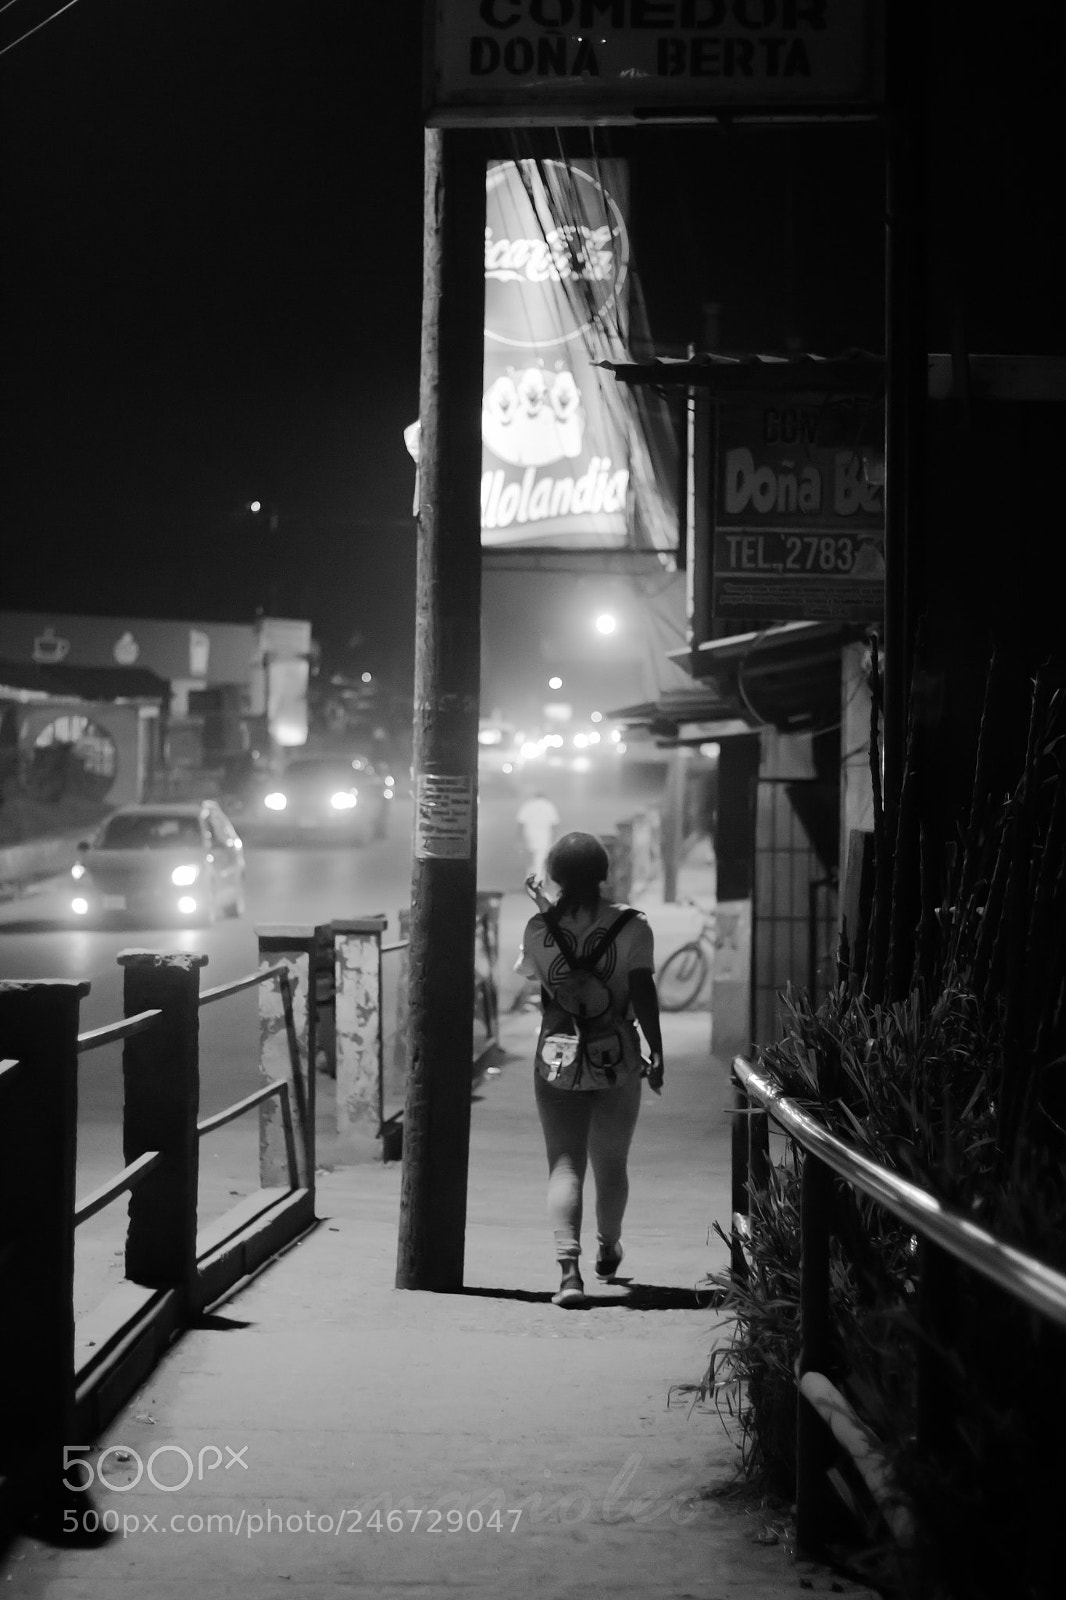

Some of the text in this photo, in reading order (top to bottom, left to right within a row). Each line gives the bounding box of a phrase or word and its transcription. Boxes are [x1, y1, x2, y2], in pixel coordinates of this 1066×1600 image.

[479, 0, 828, 30] COMEDOR
[470, 30, 812, 78] DOÑA BERTA
[725, 446, 823, 514] Doña
[786, 536, 854, 571] 2783
